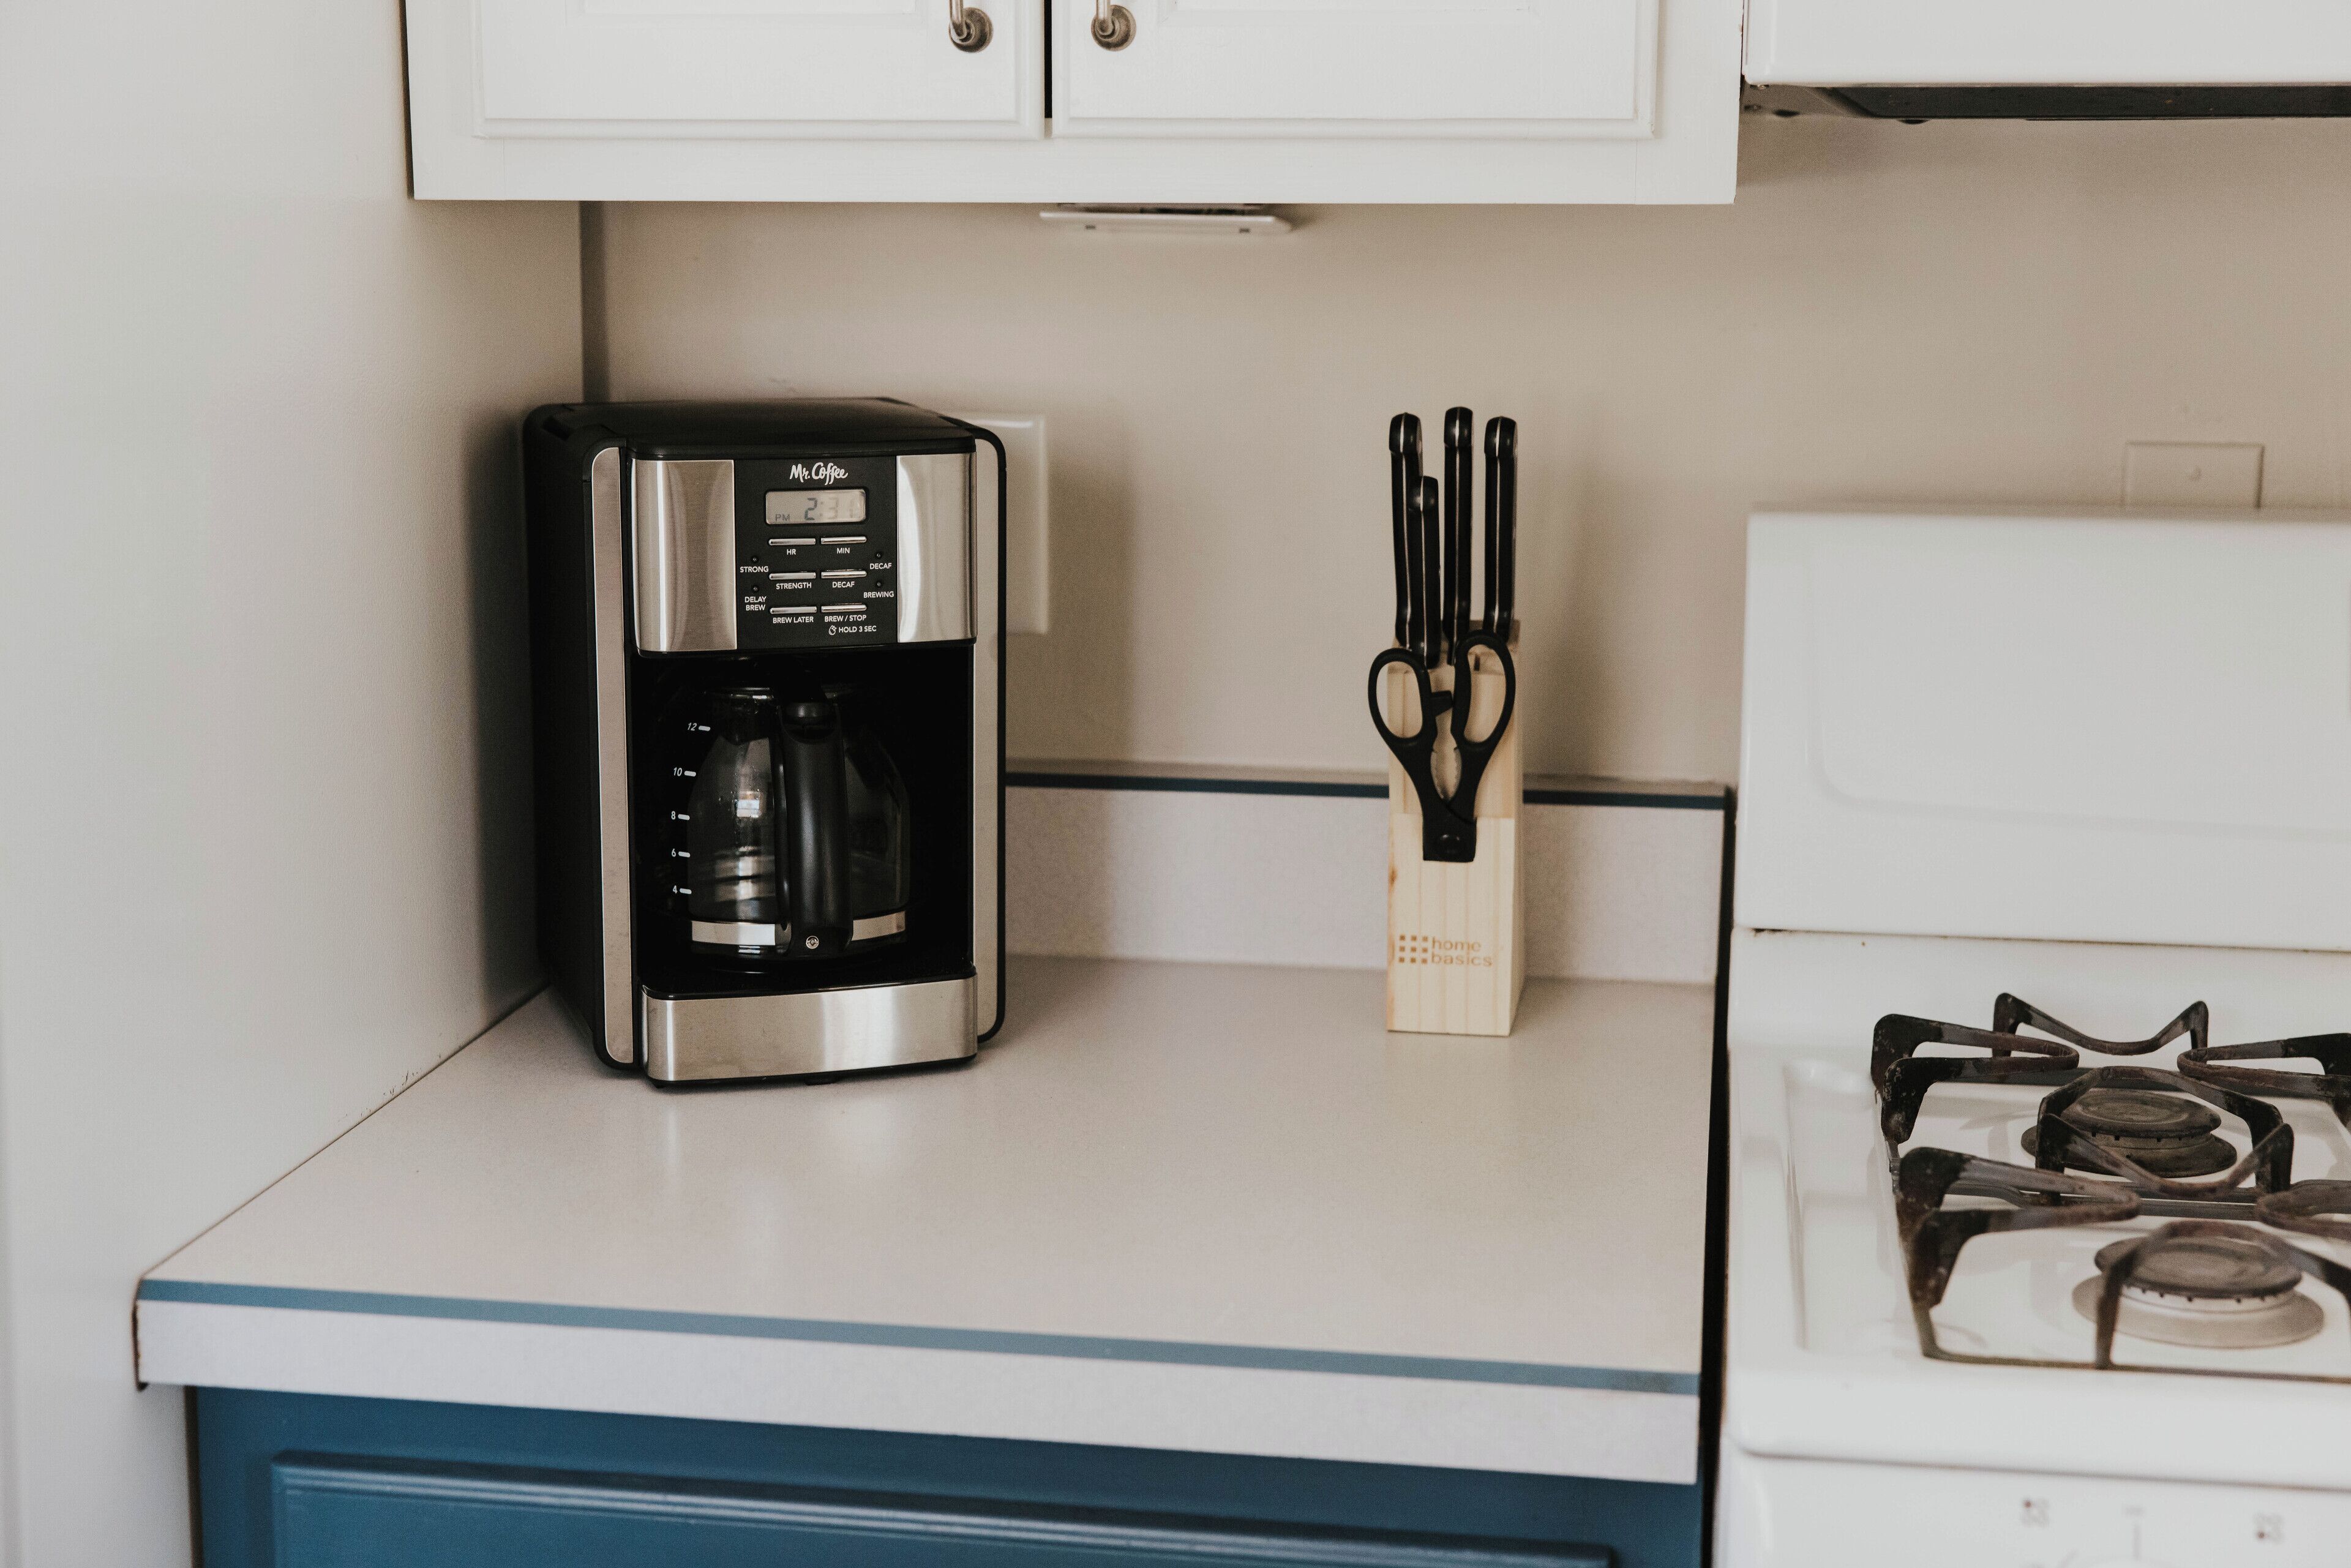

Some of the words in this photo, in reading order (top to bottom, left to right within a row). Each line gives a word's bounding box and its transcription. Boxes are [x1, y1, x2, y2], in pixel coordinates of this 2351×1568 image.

[789, 463, 811, 483] Mr.
[811, 462, 849, 486] Coffee
[776, 582, 812, 590] STRENGTH
[687, 722, 697, 731] 12
[673, 767, 683, 777] 10
[670, 811, 676, 820] 8
[671, 848, 677, 857] 6
[672, 885, 678, 894] 4
[1431, 937, 1482, 952] home
[1431, 951, 1493, 967] basics
